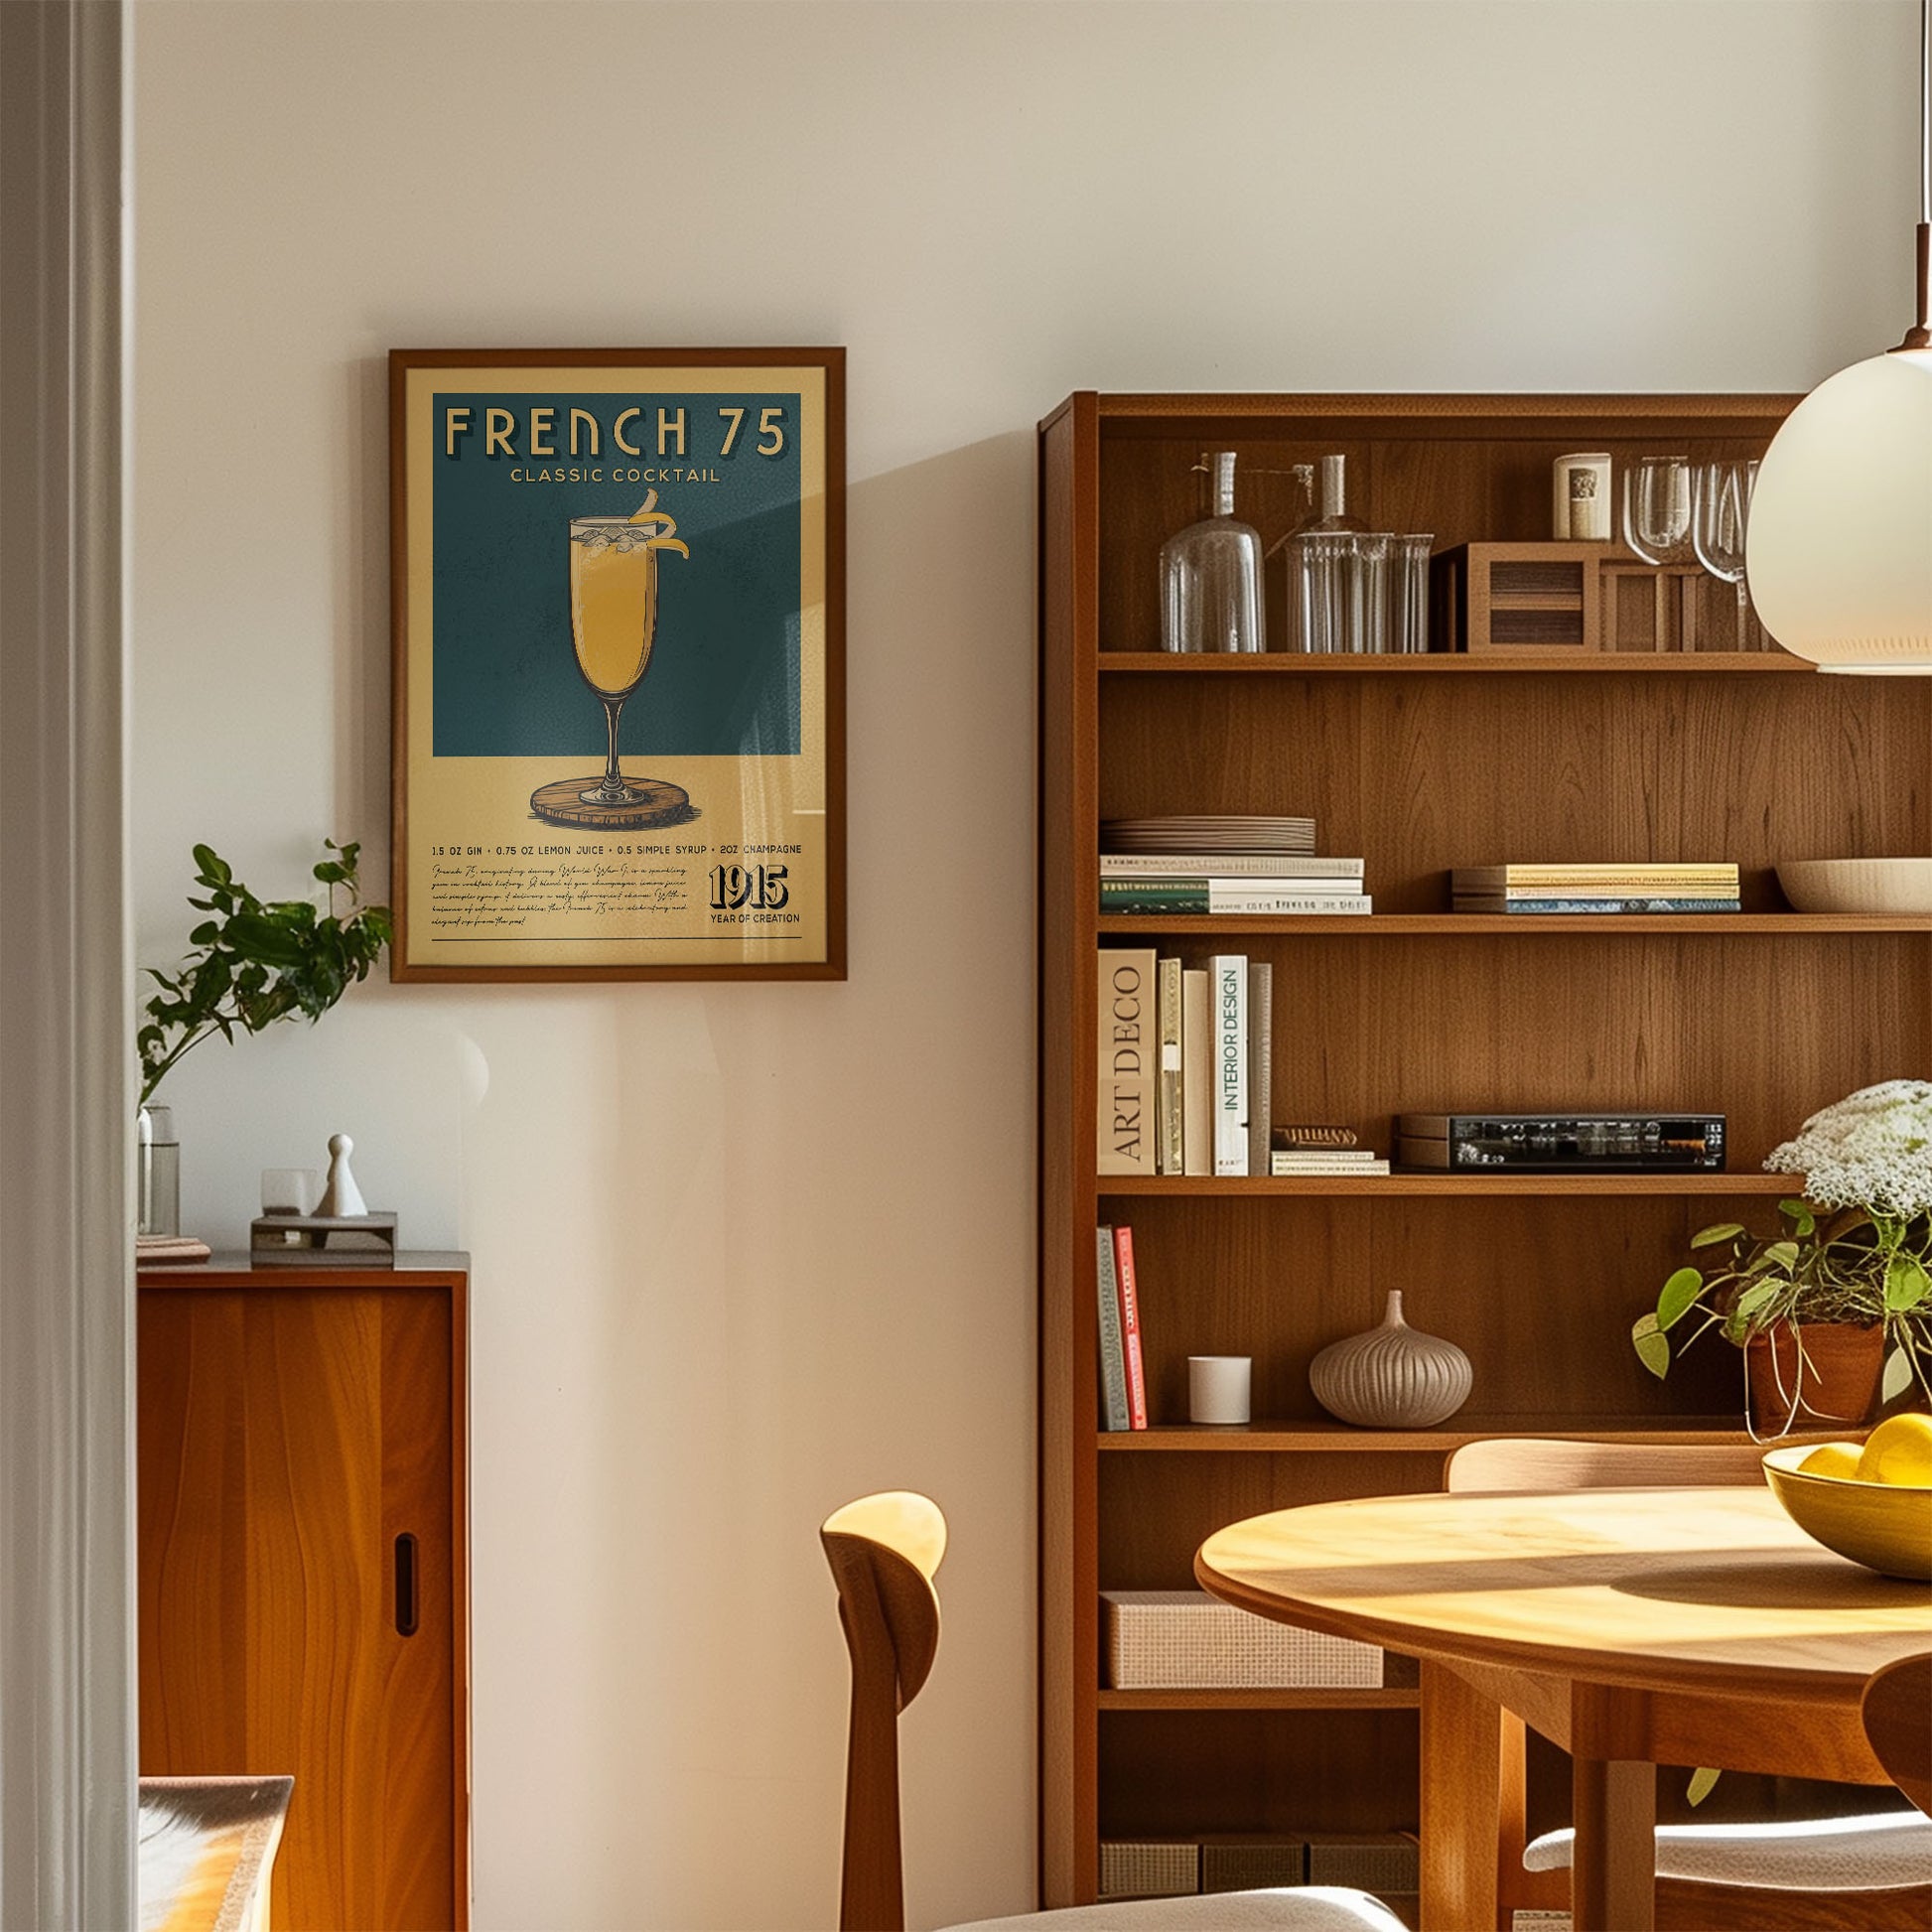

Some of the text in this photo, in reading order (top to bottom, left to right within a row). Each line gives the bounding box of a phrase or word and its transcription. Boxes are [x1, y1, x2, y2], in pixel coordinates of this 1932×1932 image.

[446, 407, 786, 460] FRENCH 75
[510, 468, 721, 483] CLASSIC COCKTAIL
[432, 846, 445, 856] 1.5
[449, 846, 462, 856] OZ
[467, 846, 483, 856] GIN
[495, 846, 517, 856] 0.75
[521, 846, 534, 855] OZ
[538, 845, 571, 855] LEMON
[576, 845, 604, 855] JUICE
[617, 845, 632, 855] 0.5
[636, 845, 670, 855] SIMPLE
[675, 845, 707, 855] SYRUP
[743, 844, 802, 854] CHAMPAGNE
[709, 864, 789, 910] 1915
[711, 913, 800, 923] YEAR OF CREATION
[1222, 969, 1238, 1111] INTERIOR DESIGN
[1112, 965, 1142, 1163] ART DECO
